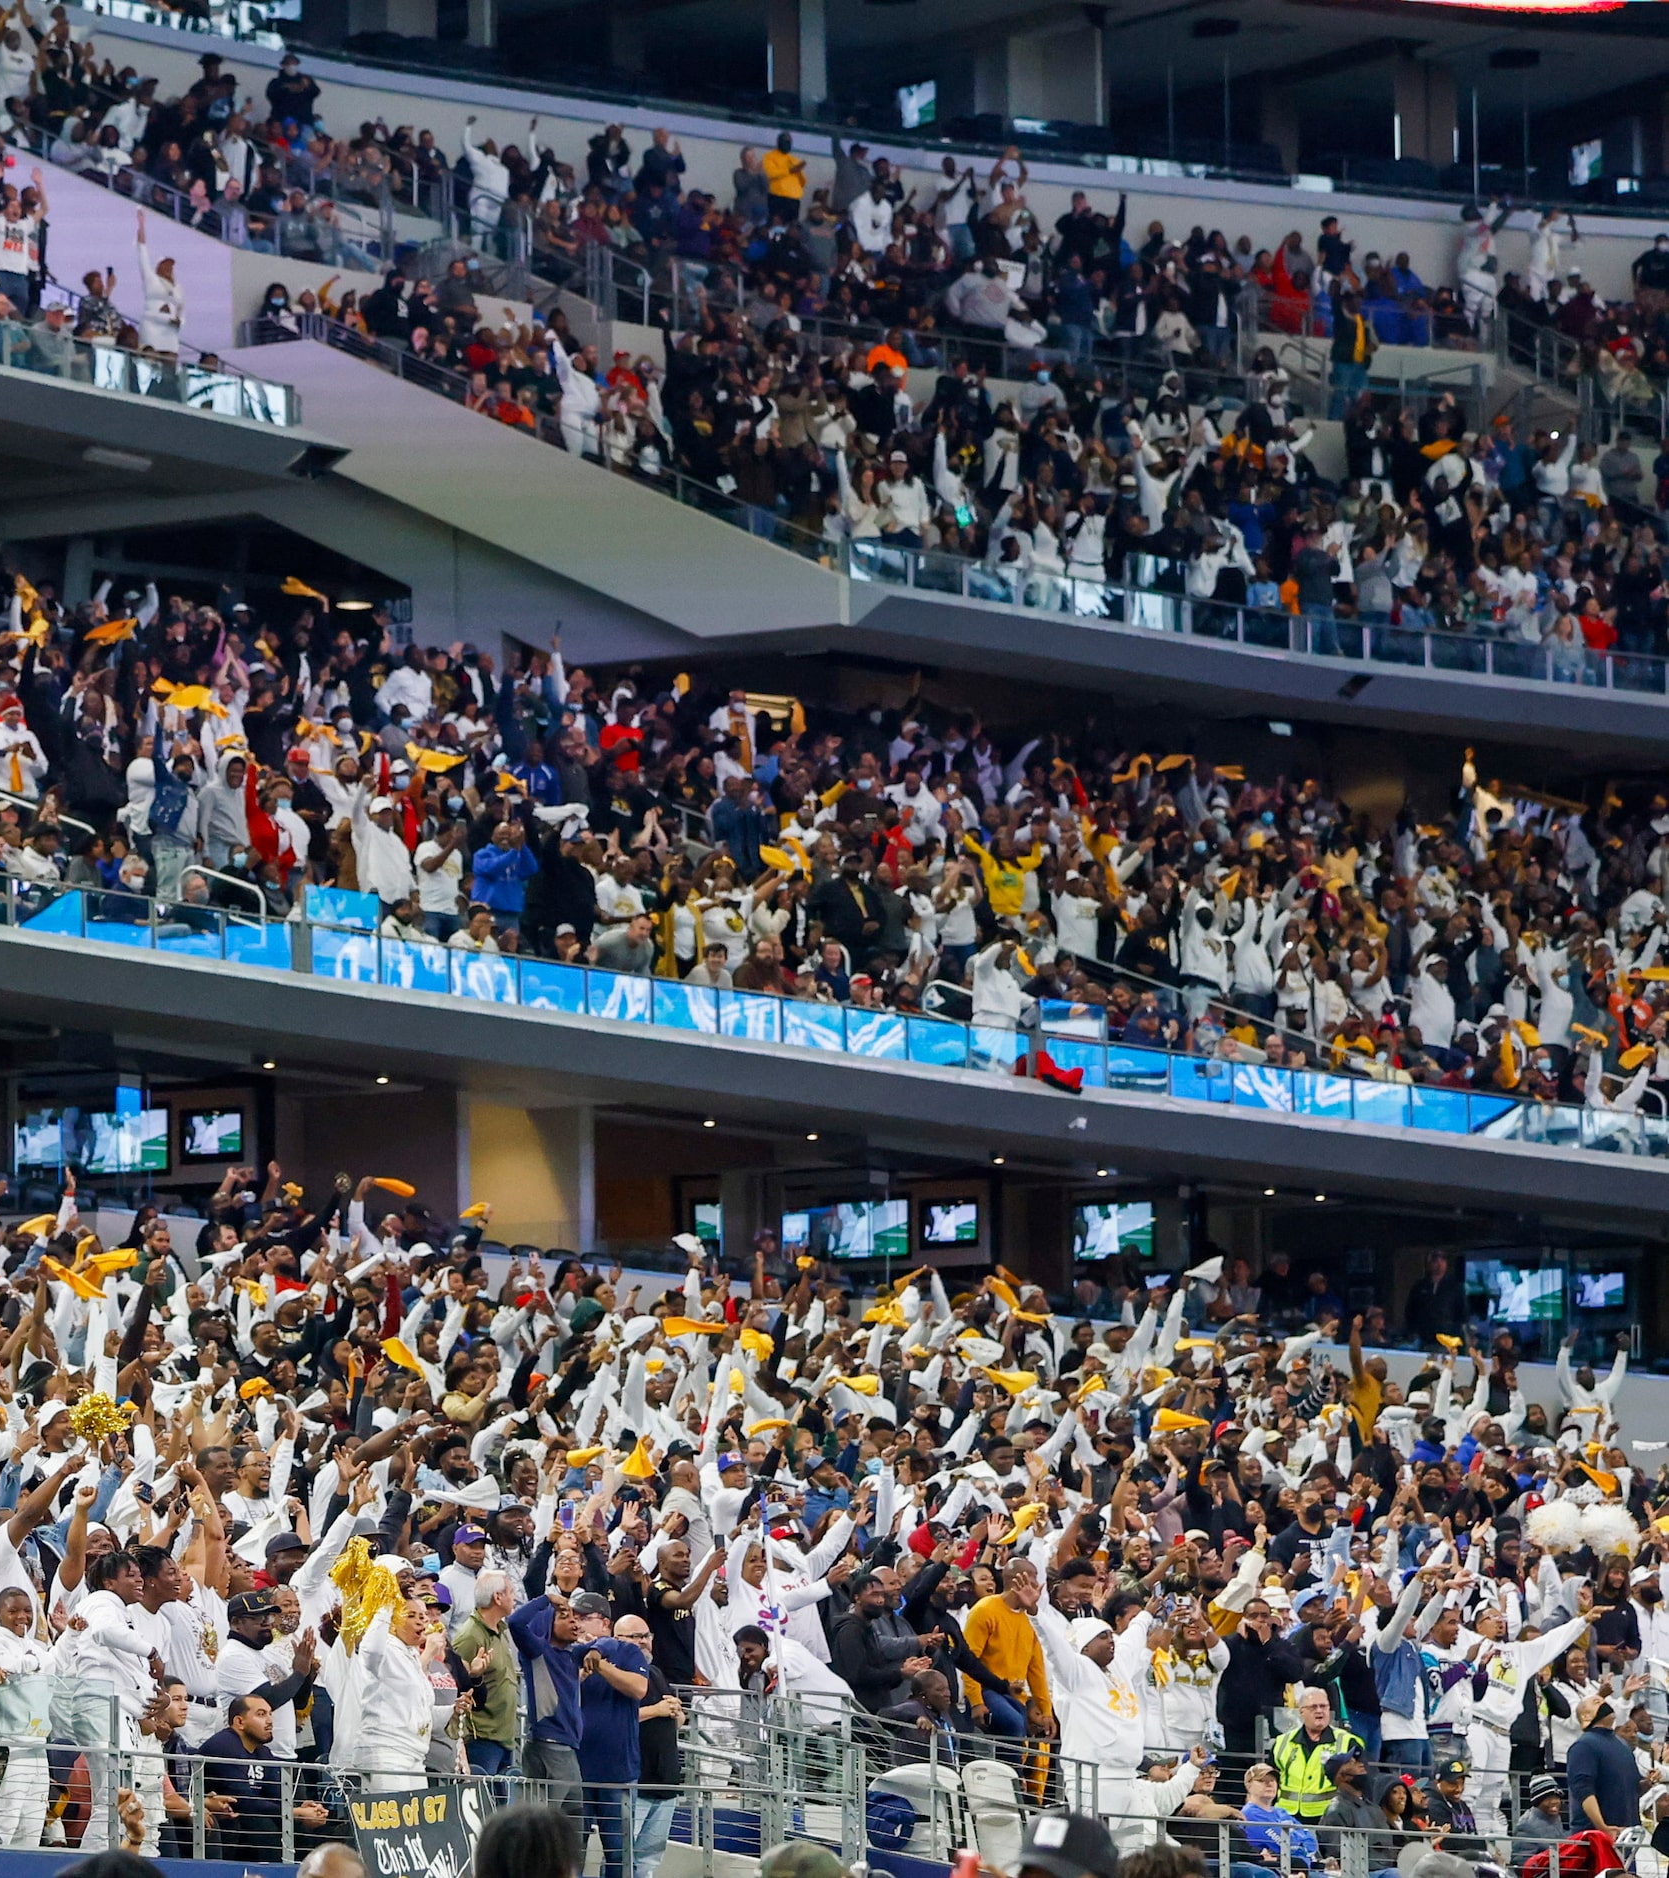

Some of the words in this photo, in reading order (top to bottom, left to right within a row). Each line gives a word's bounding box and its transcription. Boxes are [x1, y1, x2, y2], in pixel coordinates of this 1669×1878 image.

[351, 1800, 401, 1830] CLASS
[402, 1796, 420, 1827] of
[423, 1794, 447, 1824] 87
